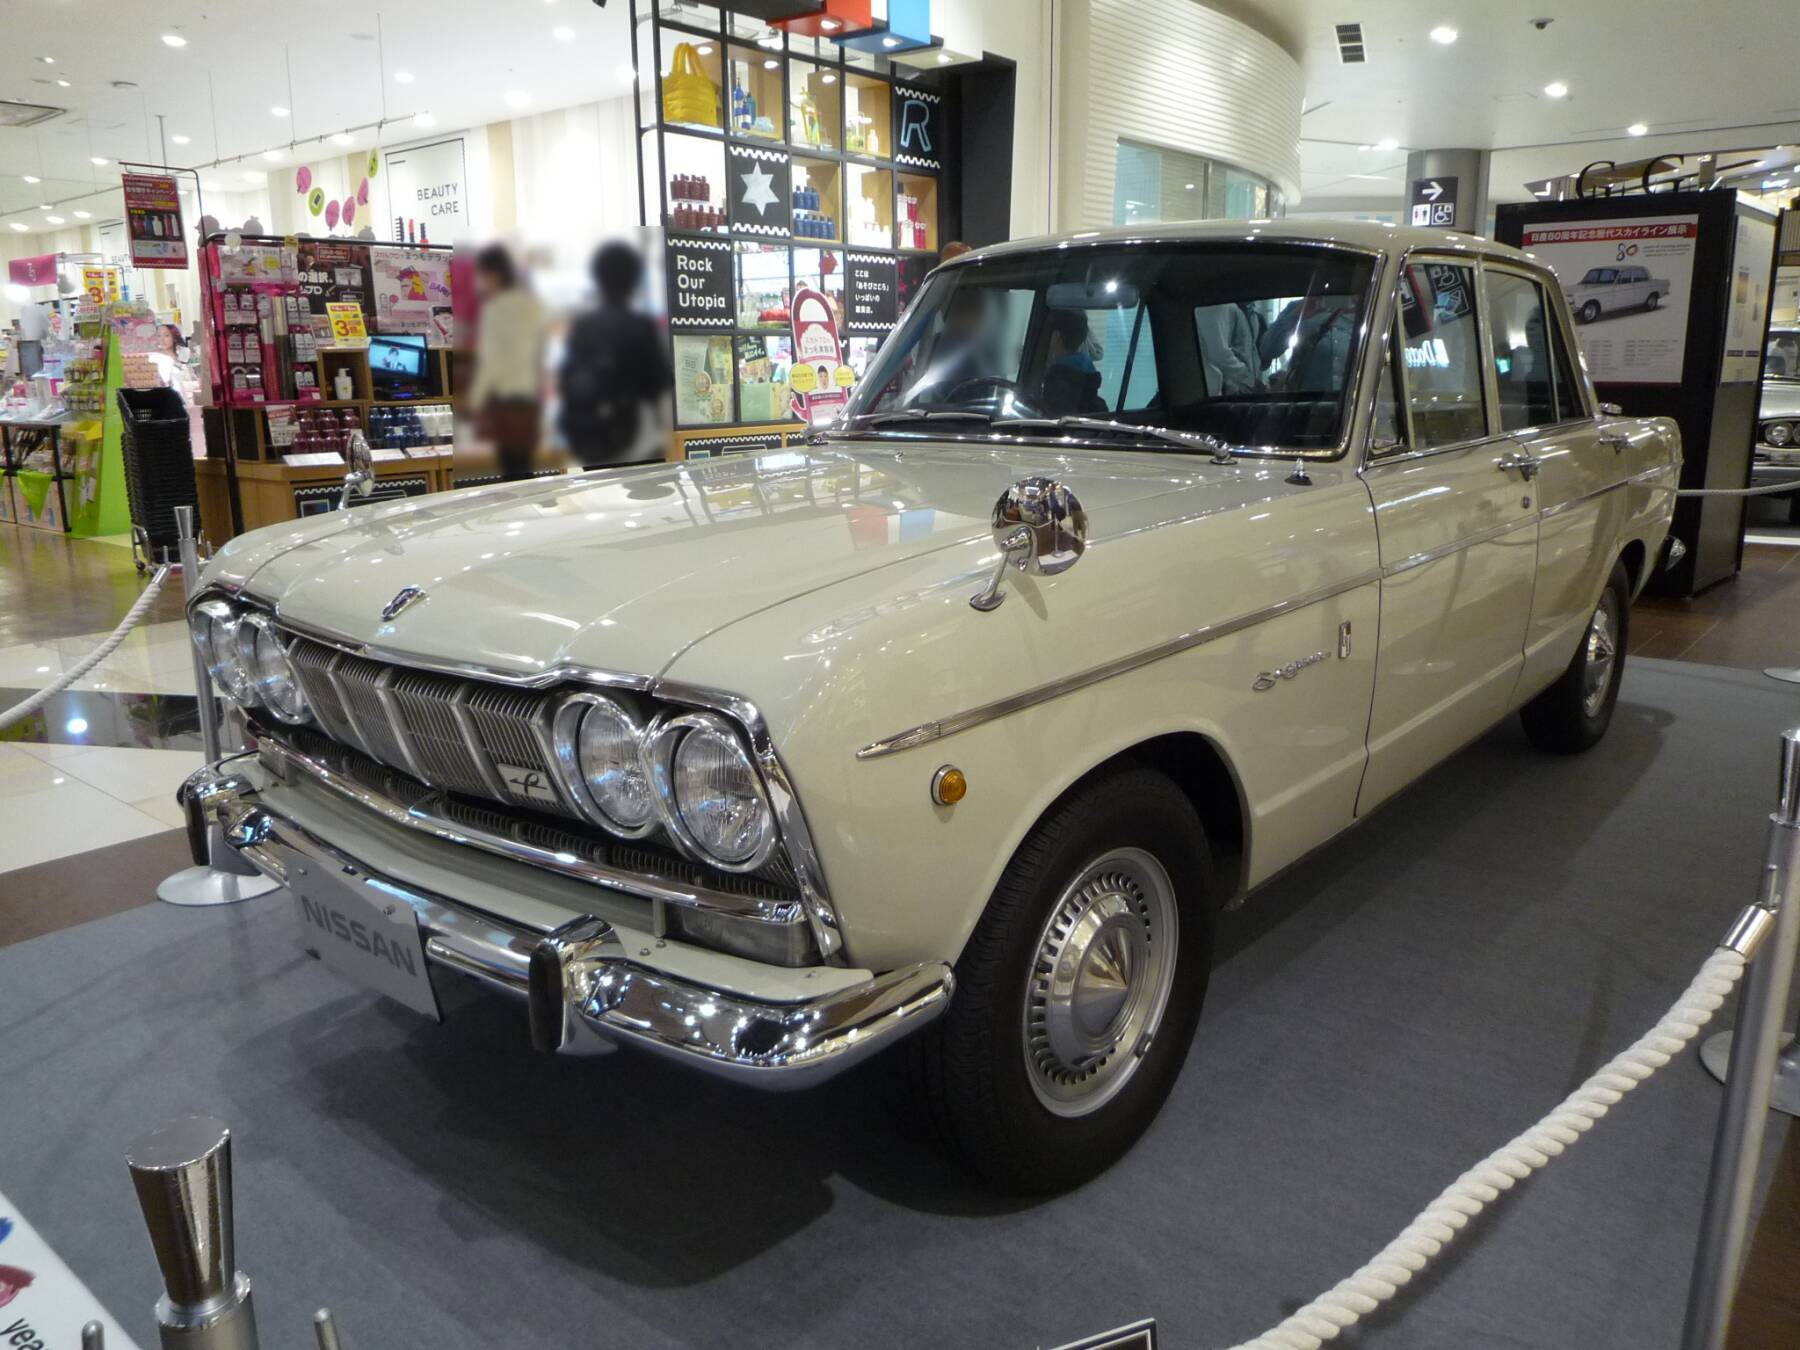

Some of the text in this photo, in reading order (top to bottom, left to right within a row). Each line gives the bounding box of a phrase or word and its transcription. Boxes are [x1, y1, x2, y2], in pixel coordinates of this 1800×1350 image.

[900, 99, 932, 152] R
[416, 183, 458, 201] BEAUTY
[431, 200, 459, 216] CARE
[676, 254, 713, 272] Rock
[677, 274, 706, 289] Our
[854, 269, 870, 278] ここは
[678, 292, 726, 311] Utopia
[854, 293, 880, 303] いっぱいの
[301, 895, 417, 977] NISSAN
